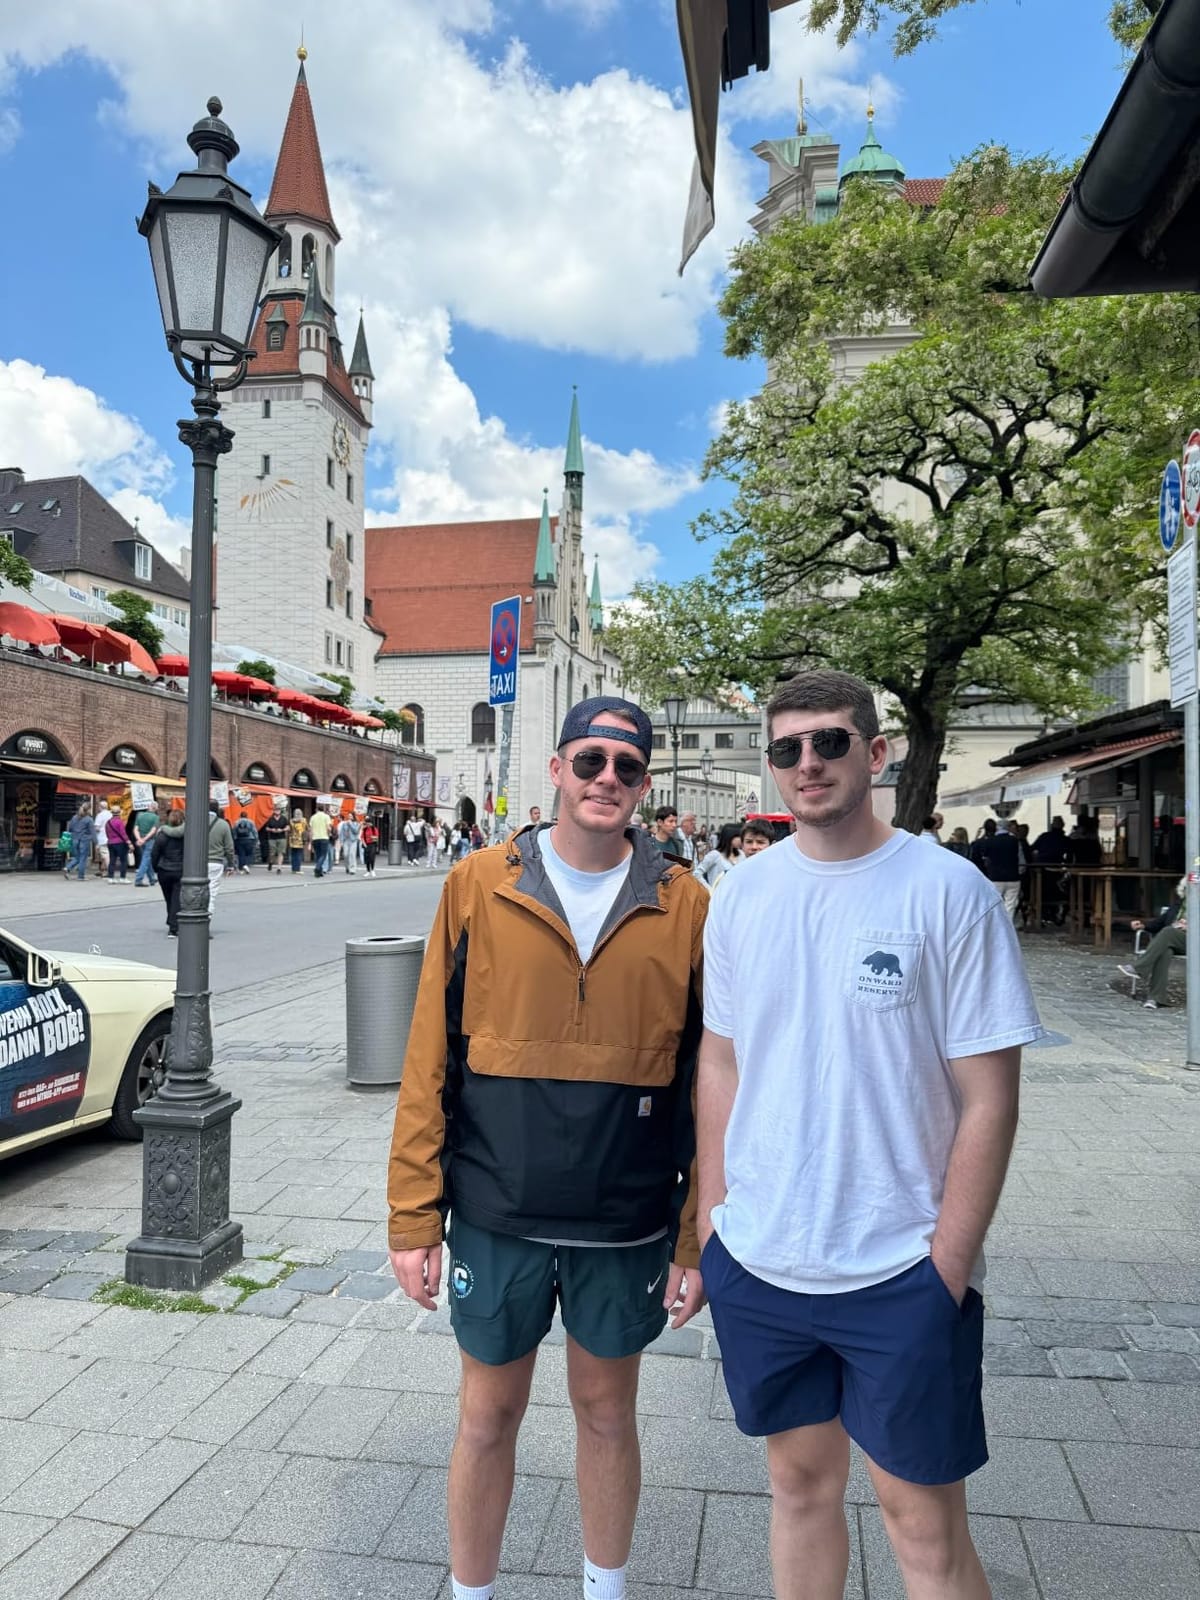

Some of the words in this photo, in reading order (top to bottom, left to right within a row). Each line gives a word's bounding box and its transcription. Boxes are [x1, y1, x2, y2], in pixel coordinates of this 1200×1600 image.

[491, 671, 514, 696] TAXI
[858, 975, 902, 986] ONWARD
[858, 985, 901, 995] RESERVE
[26, 987, 72, 1023] ROCK,
[42, 1008, 86, 1057] BOB!
